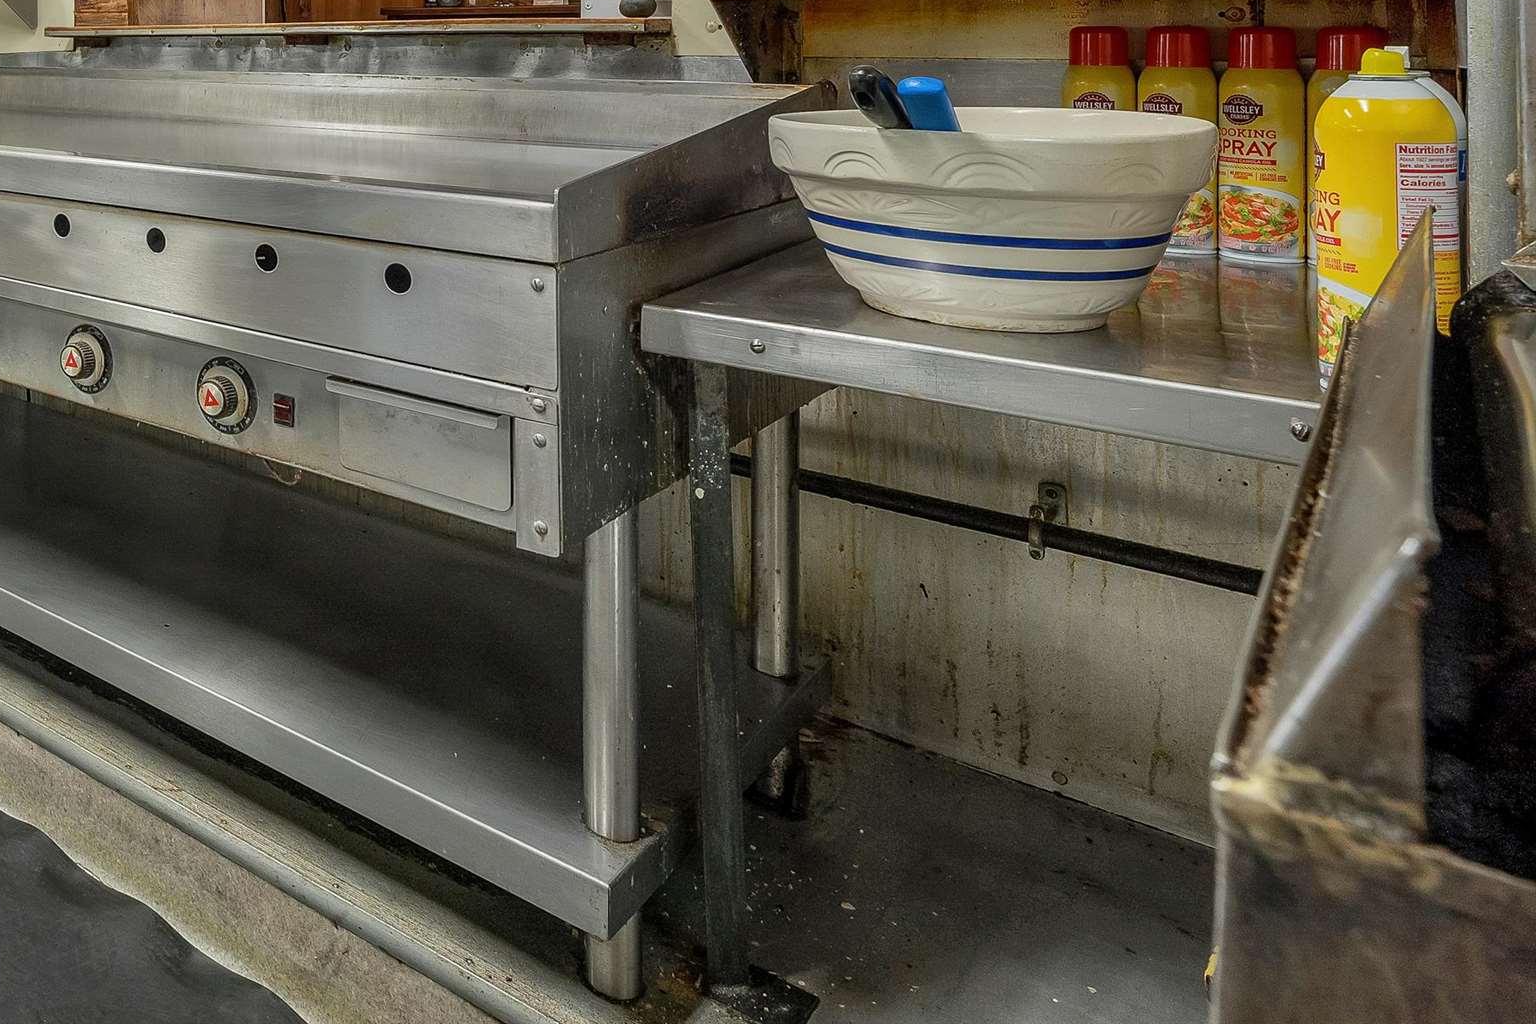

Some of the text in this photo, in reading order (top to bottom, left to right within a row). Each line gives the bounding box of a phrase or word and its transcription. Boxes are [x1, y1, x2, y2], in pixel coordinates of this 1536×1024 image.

[1074, 101, 1113, 110] WELLSLEY
[1144, 102, 1180, 113] WELLSLEY
[1224, 104, 1260, 115] WELLSLEY
[1221, 127, 1277, 139] OOKING
[1399, 145, 1444, 154] Nutrition
[1401, 179, 1446, 187] Calories
